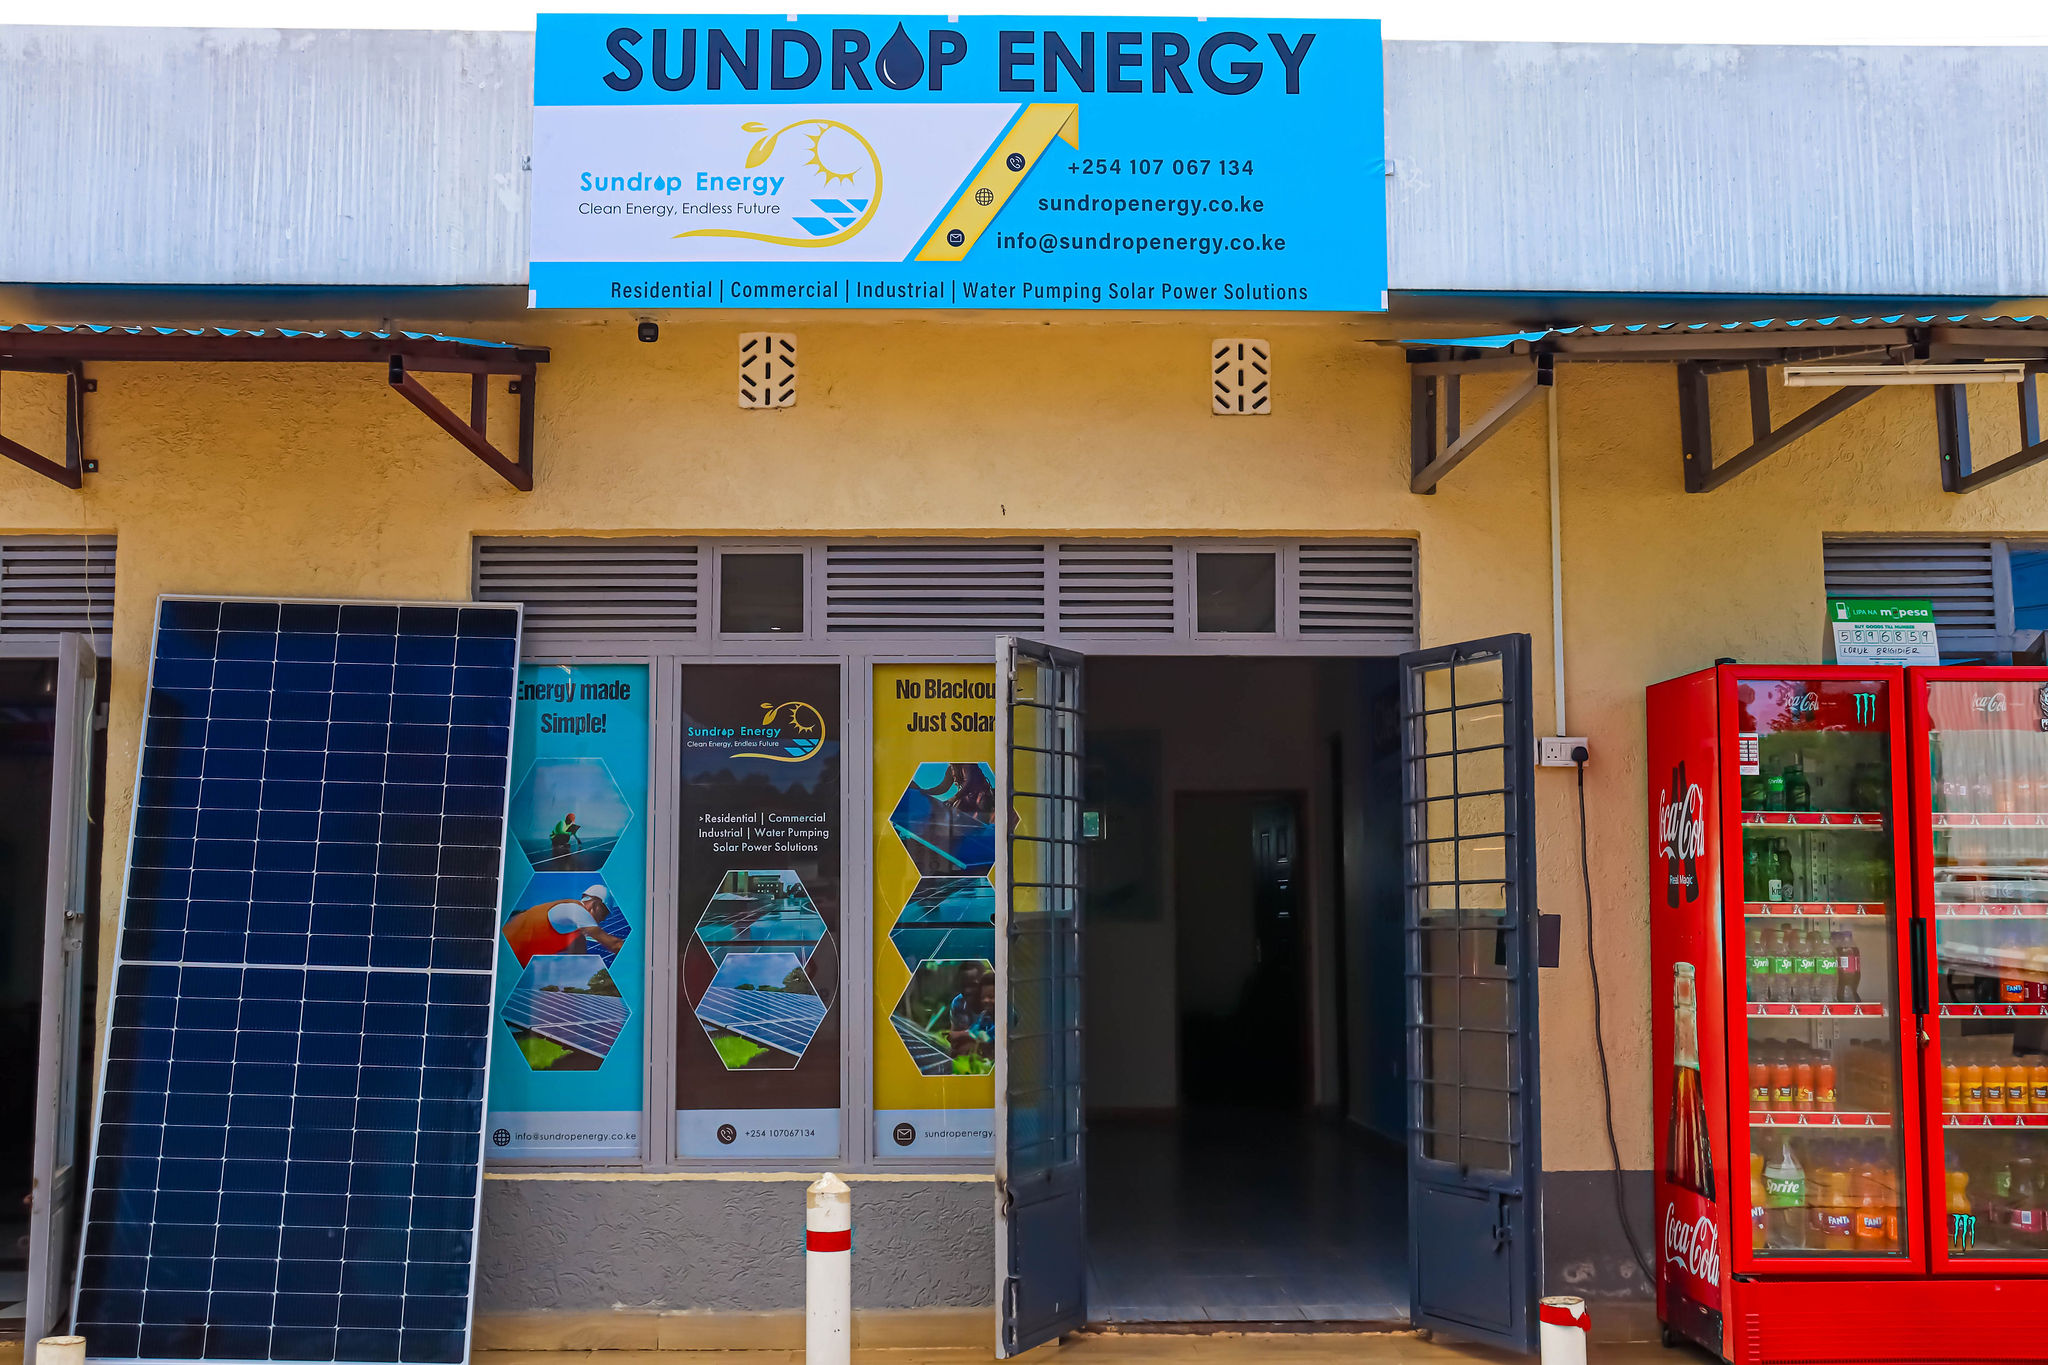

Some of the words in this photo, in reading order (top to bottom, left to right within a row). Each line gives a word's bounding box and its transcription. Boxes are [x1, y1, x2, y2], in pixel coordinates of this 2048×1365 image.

[999, 30, 1316, 95] ENERGY
[1067, 159, 1122, 175] +254
[1129, 159, 1165, 175] 107
[1172, 159, 1211, 175] 067
[1218, 159, 1254, 176] 134
[580, 171, 682, 196] Sundrop
[696, 171, 785, 196] Energy
[578, 202, 622, 215] Clean
[626, 202, 678, 218] Energy,
[682, 202, 733, 215] Endless
[737, 202, 780, 215] Future
[1038, 194, 1264, 216] sundropenergy.co.ke
[996, 231, 1286, 255] info@sundropenergy.co.ke
[611, 281, 712, 299] Residential
[731, 281, 838, 298] Commercial
[856, 281, 945, 298] Industrial
[963, 281, 1016, 299] Water
[1022, 281, 1101, 303] Pumping
[1109, 281, 1155, 300] Solar
[1162, 282, 1217, 300] Power
[1224, 283, 1308, 300] Solutions
[580, 680, 631, 700] made
[896, 679, 921, 699] No
[925, 679, 996, 699] Blackou
[541, 713, 606, 735] Simple!
[907, 712, 946, 732] Just
[951, 712, 996, 732] Solar
[687, 726, 735, 738] Sundrop
[740, 726, 781, 738] Energy
[686, 740, 708, 748] Clean
[734, 740, 758, 748] Endless
[768, 812, 826, 823] Commercial
[699, 827, 743, 838] Industrial
[754, 827, 785, 837] Water
[788, 827, 829, 839] Pumping
[713, 842, 739, 852] Solar
[742, 842, 772, 852] Power
[774, 841, 818, 852] Solutions
[515, 1132, 636, 1142] info@sundropenergy.co.ke
[745, 1129, 766, 1138] +254
[769, 1129, 815, 1137] 107067134
[1766, 1180, 1799, 1194] Sprite
